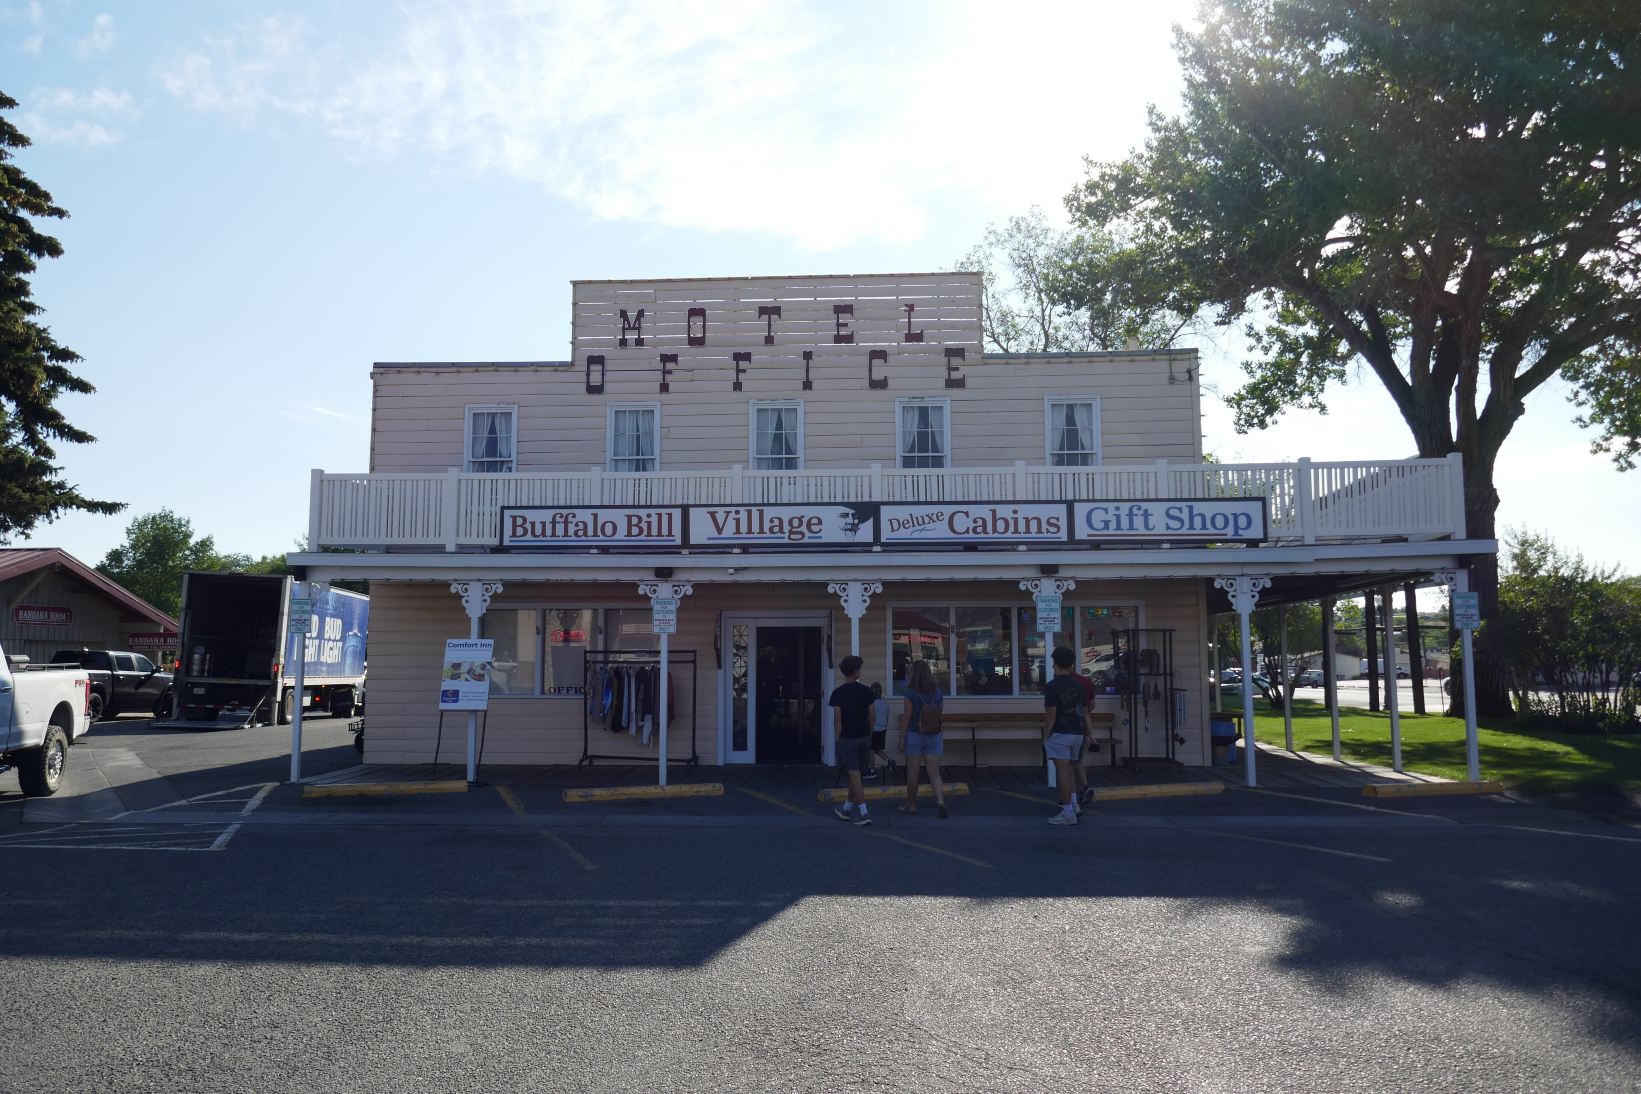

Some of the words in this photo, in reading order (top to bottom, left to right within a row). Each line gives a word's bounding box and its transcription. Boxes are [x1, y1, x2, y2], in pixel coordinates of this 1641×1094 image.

[619, 303, 924, 347] MOTEL
[586, 347, 966, 394] OFFICE
[509, 512, 618, 539] Buffalo
[625, 511, 676, 538] Bill
[706, 509, 823, 541] Village
[888, 510, 945, 533] Deluxe
[947, 508, 1061, 535] Cabins
[1085, 505, 1156, 532] Gift
[1164, 505, 1253, 537] Shop
[18, 610, 48, 621] BANDANA
[49, 611, 68, 622] ROOM
[324, 616, 342, 640] BUD
[128, 637, 165, 645] BANDANA
[320, 640, 343, 664] LIGHT
[447, 641, 478, 649] Comfort
[548, 686, 585, 694] OFFIC
